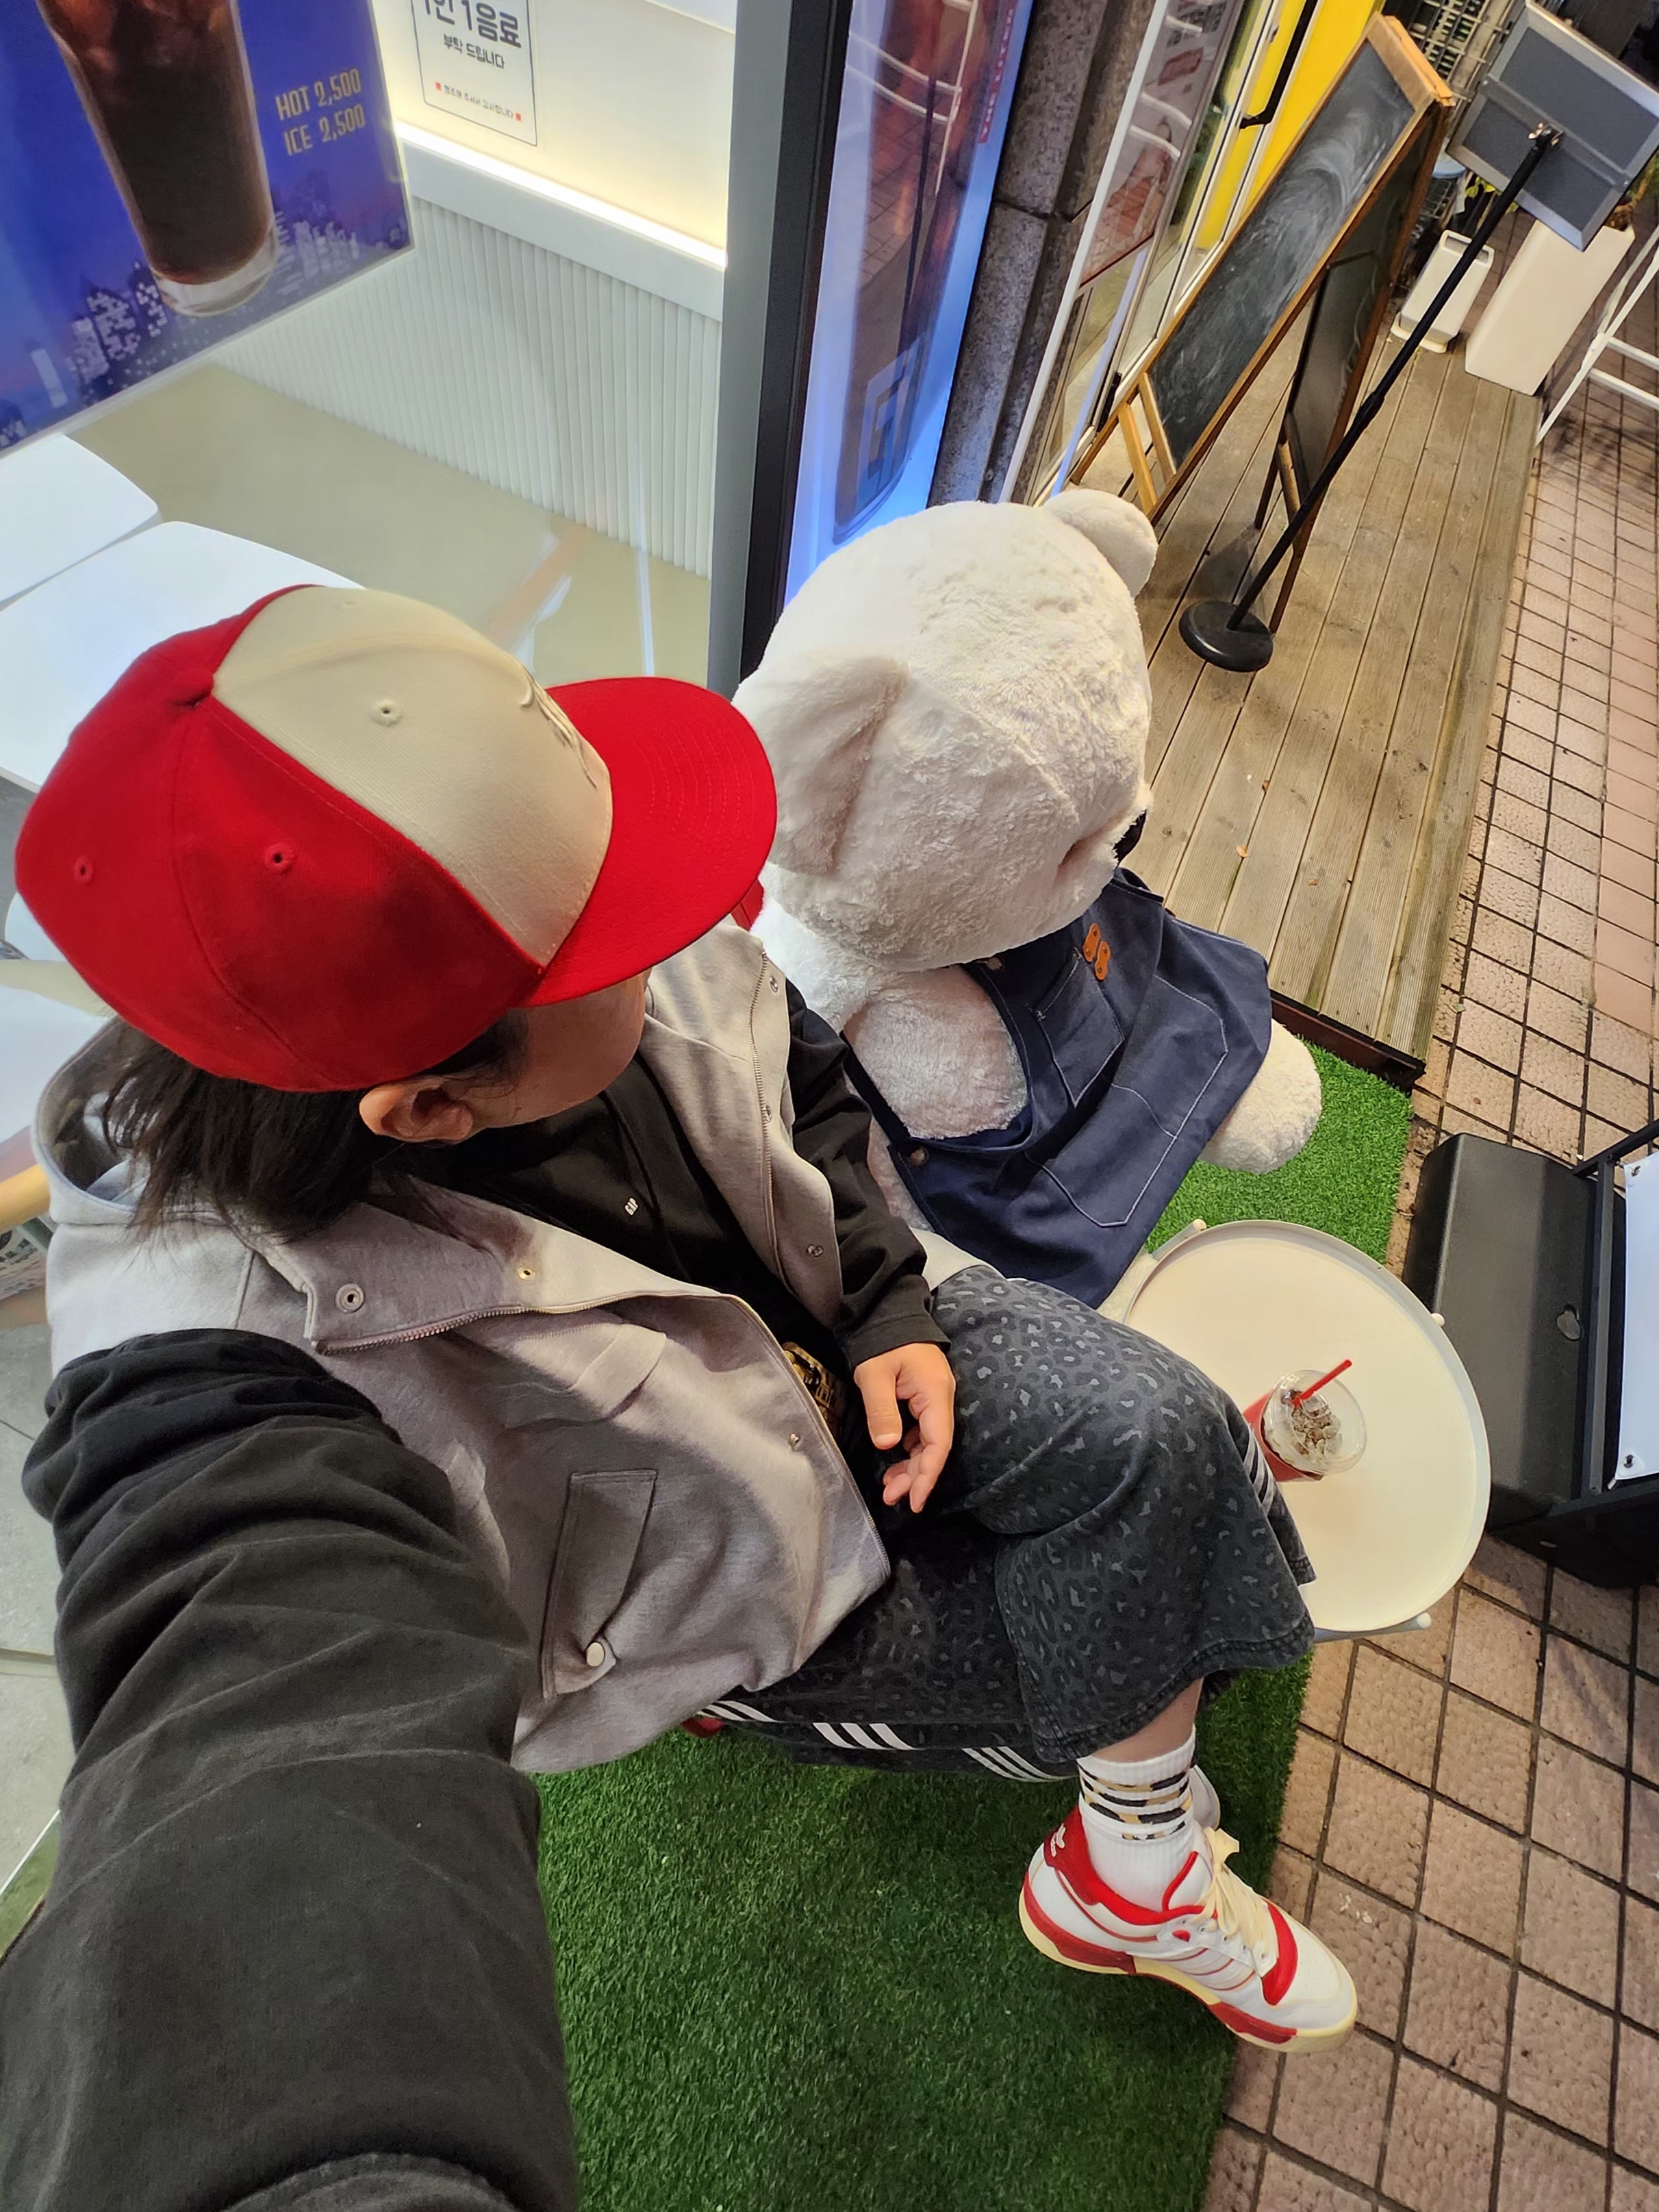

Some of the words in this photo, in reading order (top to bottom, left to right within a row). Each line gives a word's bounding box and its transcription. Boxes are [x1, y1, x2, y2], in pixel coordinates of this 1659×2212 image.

[444, 34, 463, 54] 부탁
[466, 42, 505, 70] 드립니다
[275, 86, 310, 121] HOT
[314, 68, 362, 107] 2,500
[283, 124, 313, 156] ICE
[319, 103, 366, 142] 2,500
[624, 1198, 638, 1216] GAP
